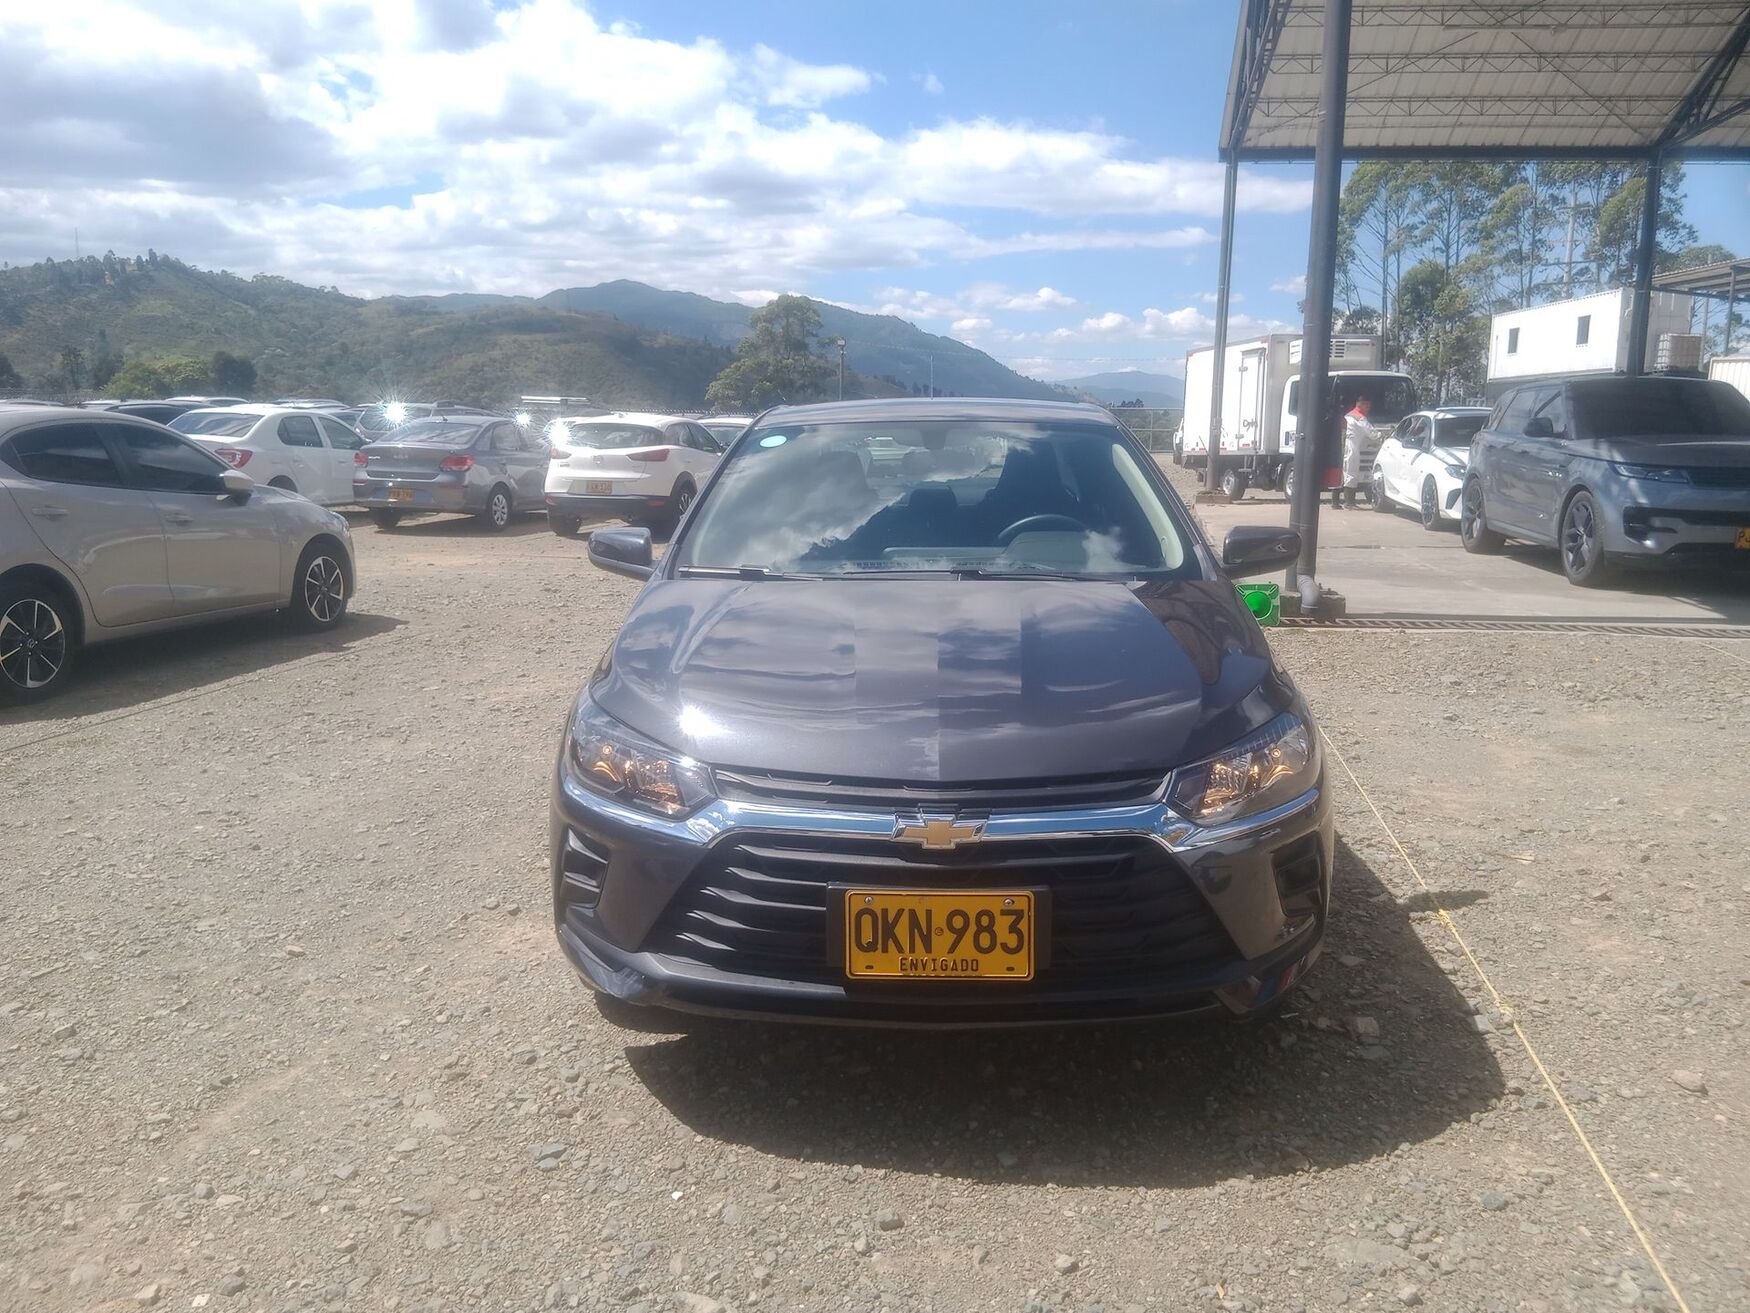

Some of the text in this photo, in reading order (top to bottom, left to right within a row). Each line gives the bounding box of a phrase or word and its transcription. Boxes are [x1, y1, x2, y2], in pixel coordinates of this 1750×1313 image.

[854, 908, 1025, 954] QKN 983
[899, 957, 978, 972] ENVIGADO
